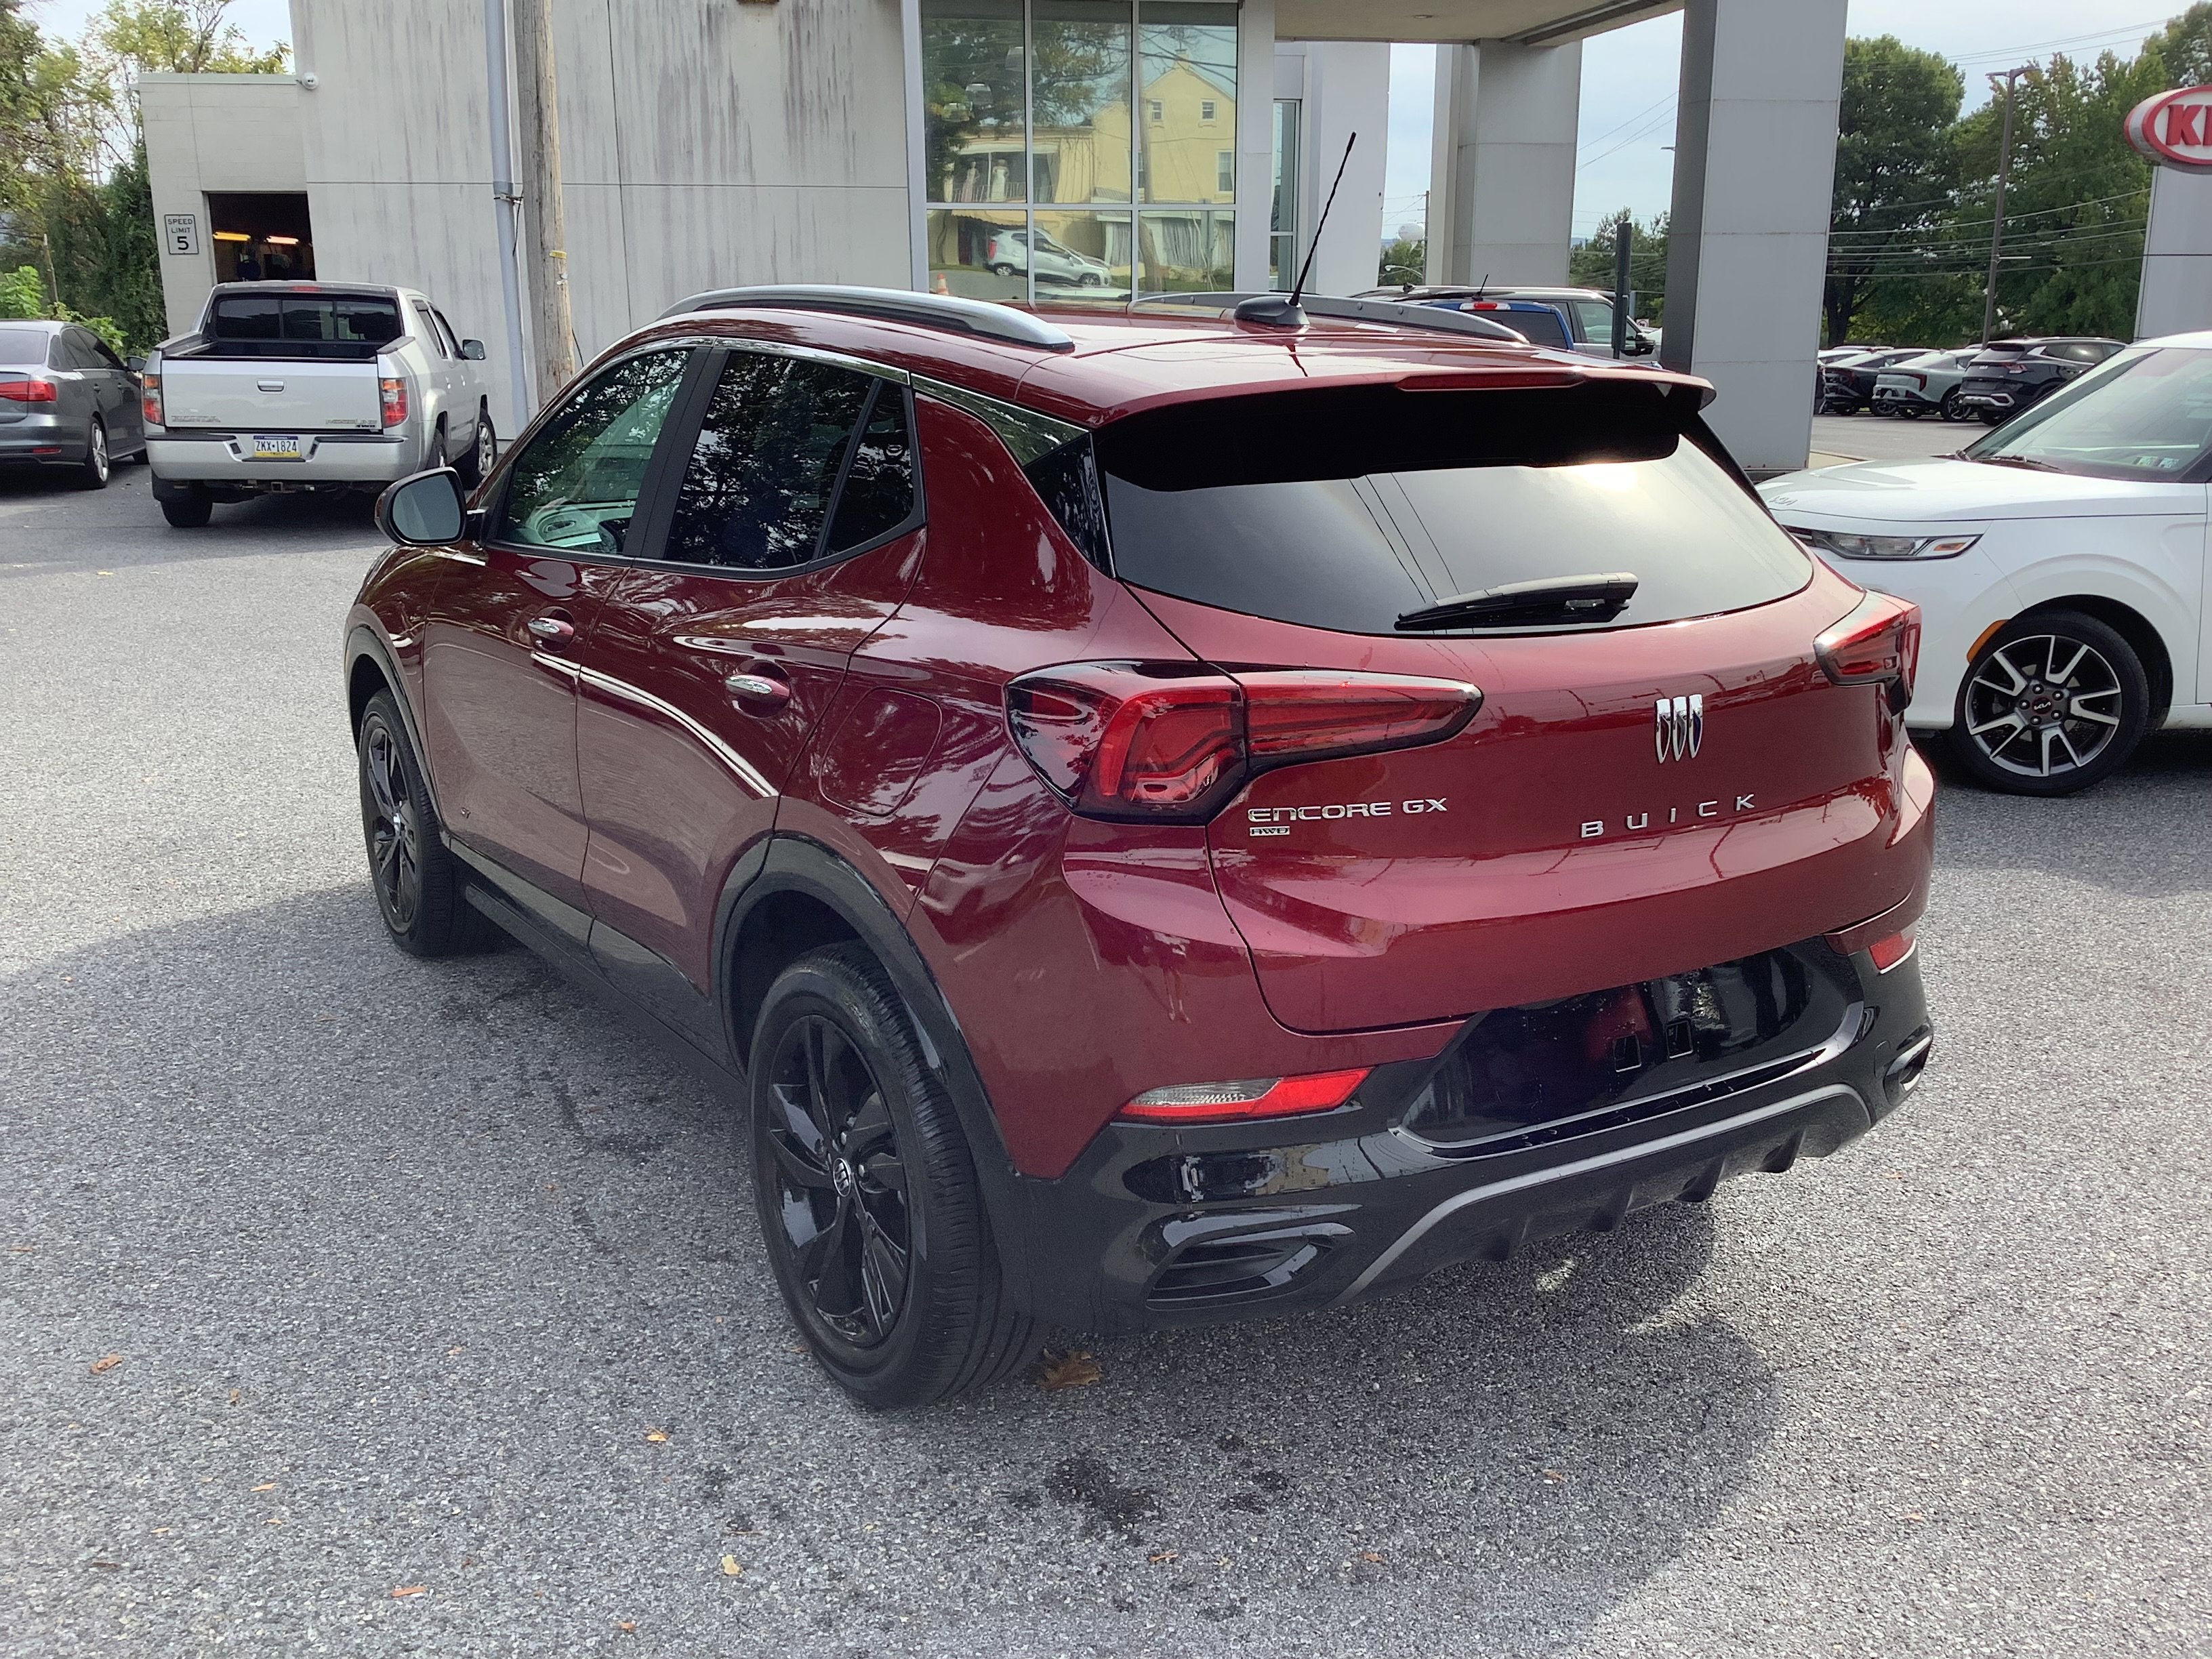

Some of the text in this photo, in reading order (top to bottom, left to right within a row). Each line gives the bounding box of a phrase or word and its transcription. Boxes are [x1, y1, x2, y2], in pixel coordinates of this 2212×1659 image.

[177, 236, 189, 251] 5
[1248, 798, 1448, 823] ENCORE GX
[1581, 794, 1755, 838] BUICK
[1250, 827, 1289, 836] AWD
